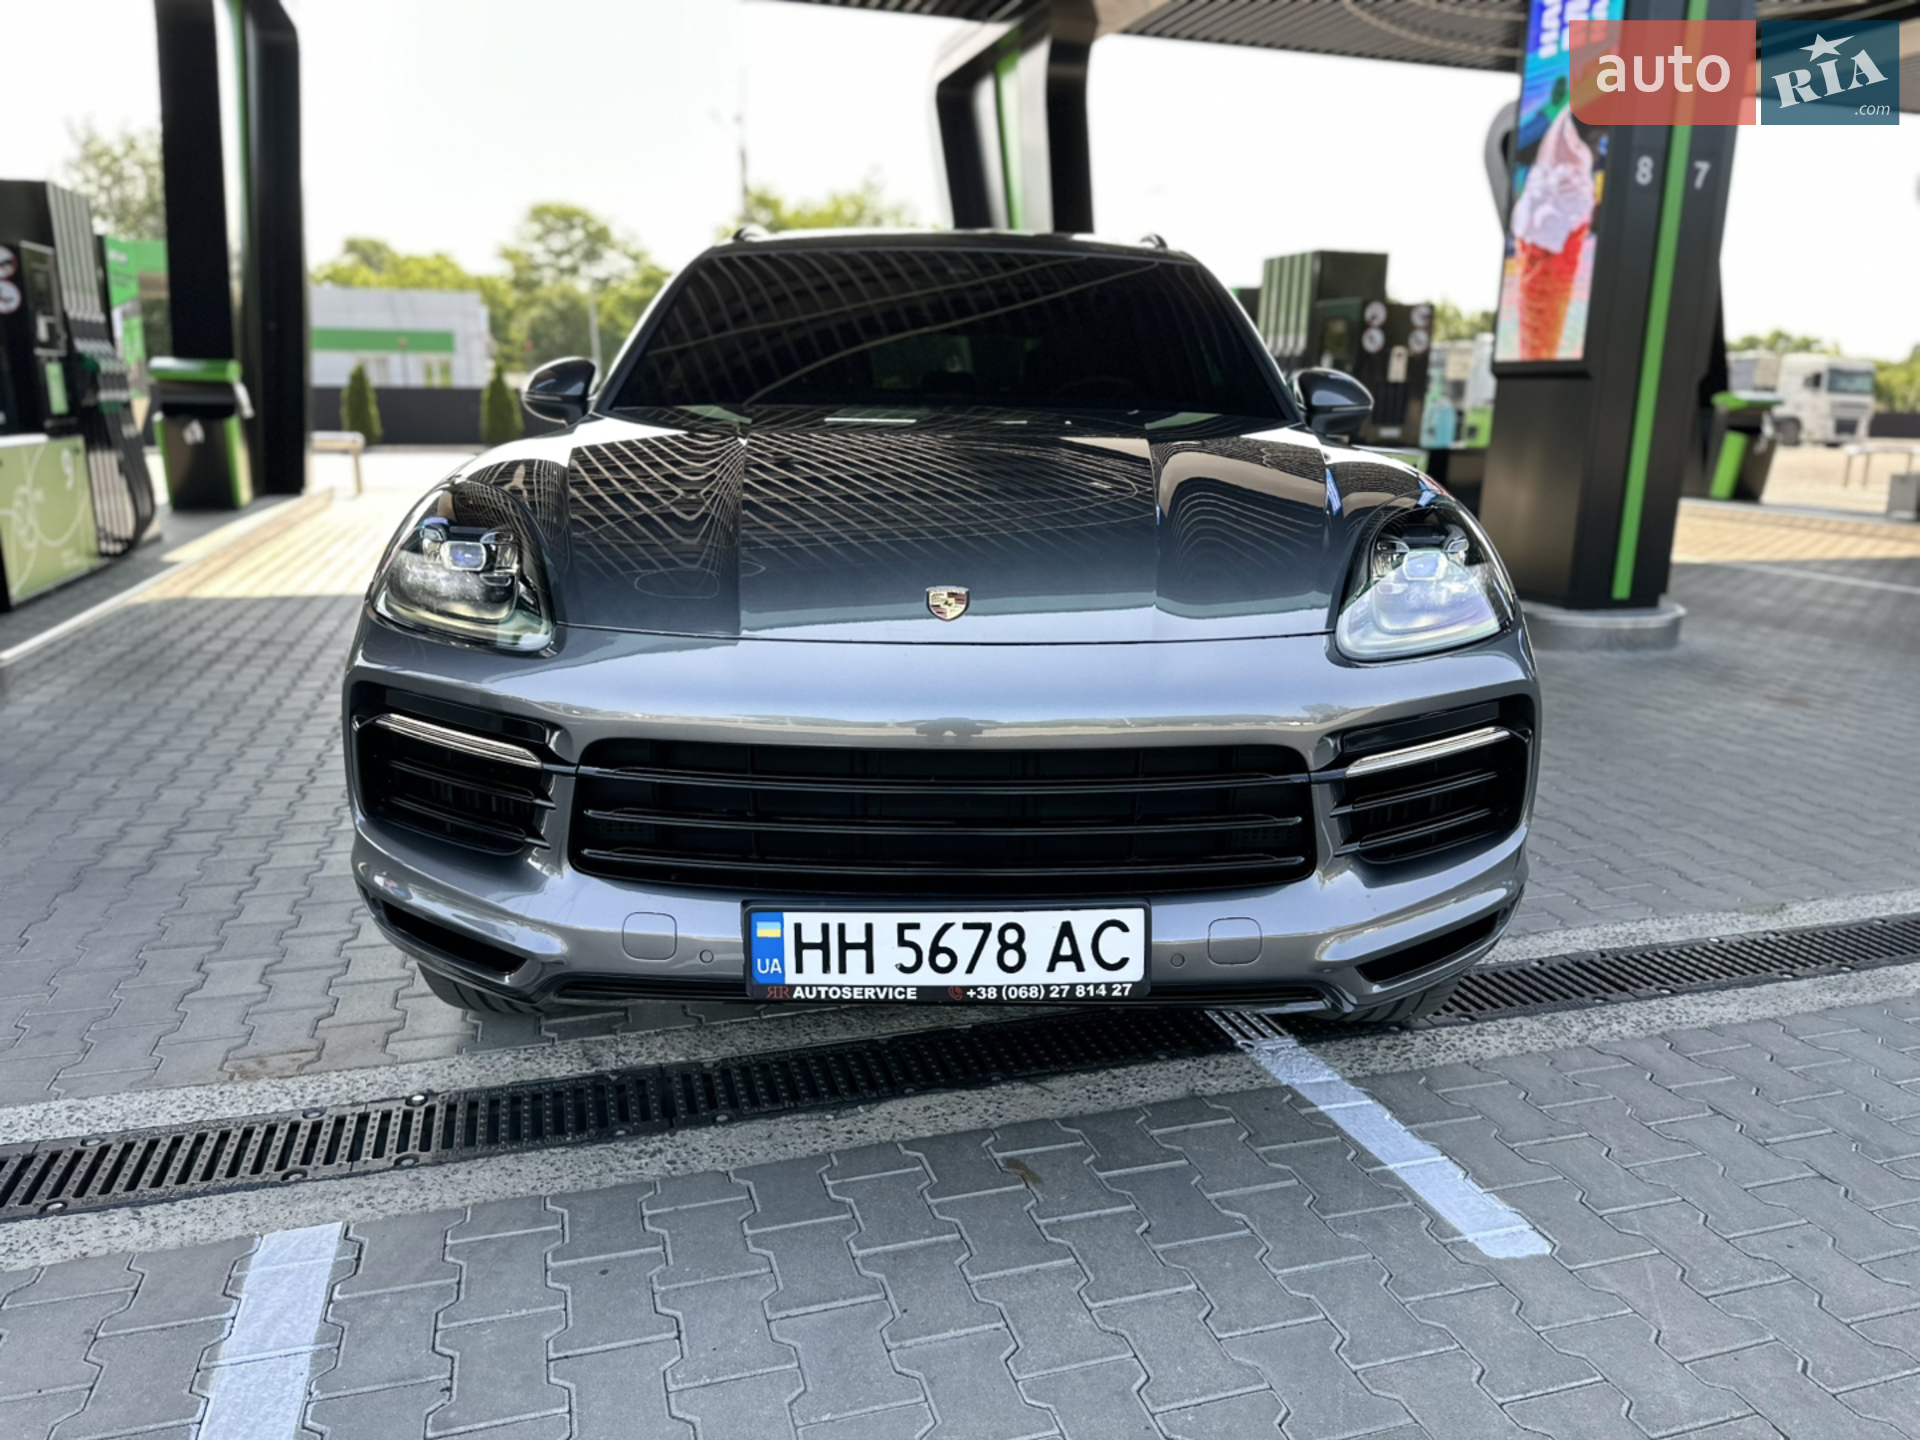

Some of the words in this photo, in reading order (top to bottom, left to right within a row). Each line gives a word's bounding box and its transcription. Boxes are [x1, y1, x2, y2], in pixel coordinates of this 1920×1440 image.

[1636, 155, 1654, 186] 8
[1694, 161, 1711, 190] 7
[794, 922, 875, 974] HH
[894, 921, 1027, 974] 5678
[1046, 919, 1130, 973] AC
[757, 958, 782, 974] UA
[793, 986, 918, 1000] AUTOSERVICE
[966, 987, 997, 999] +38
[1002, 984, 1045, 1000] (068)
[1049, 985, 1070, 998] 27
[1075, 984, 1107, 997] 814
[1111, 983, 1132, 996] 27
